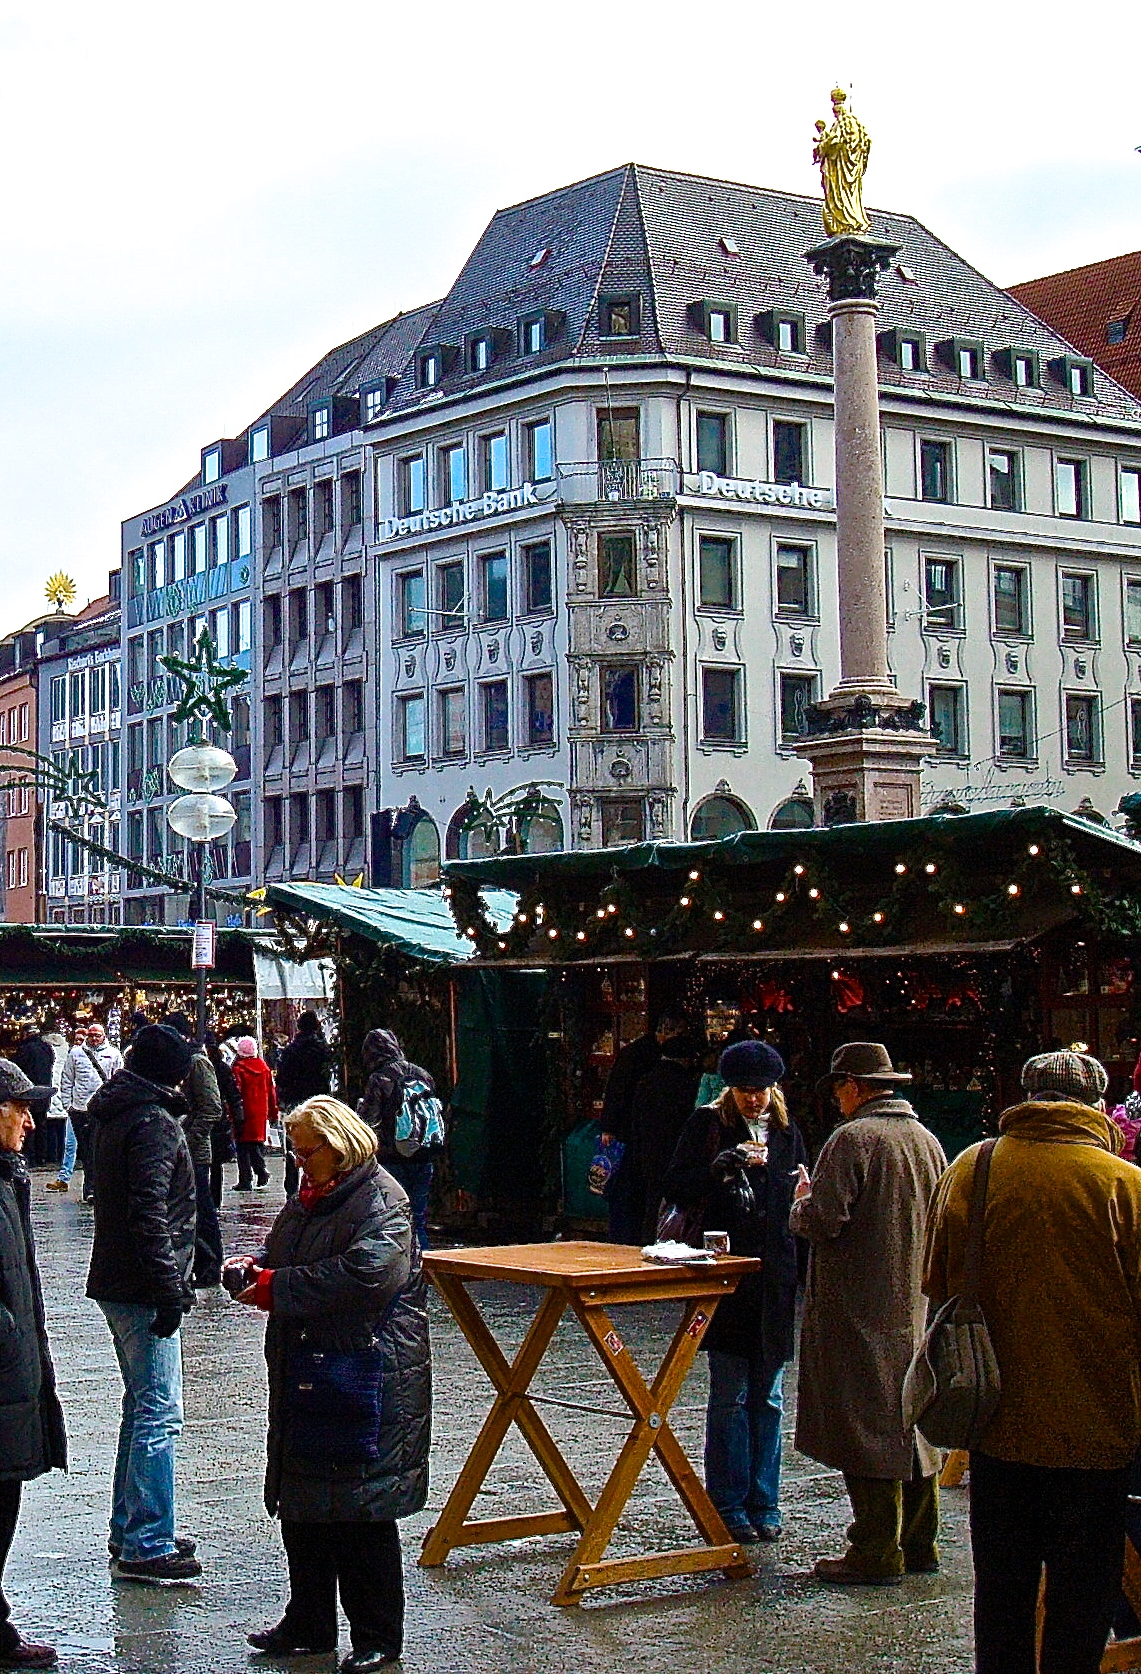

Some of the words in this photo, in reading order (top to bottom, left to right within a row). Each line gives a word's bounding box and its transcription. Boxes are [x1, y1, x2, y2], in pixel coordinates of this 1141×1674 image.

[141, 506, 177, 538] AUGEN
[189, 483, 229, 515] KLINIK
[384, 499, 475, 539] Deutsche
[482, 482, 539, 515] Bank
[699, 470, 823, 508] Deutsche
